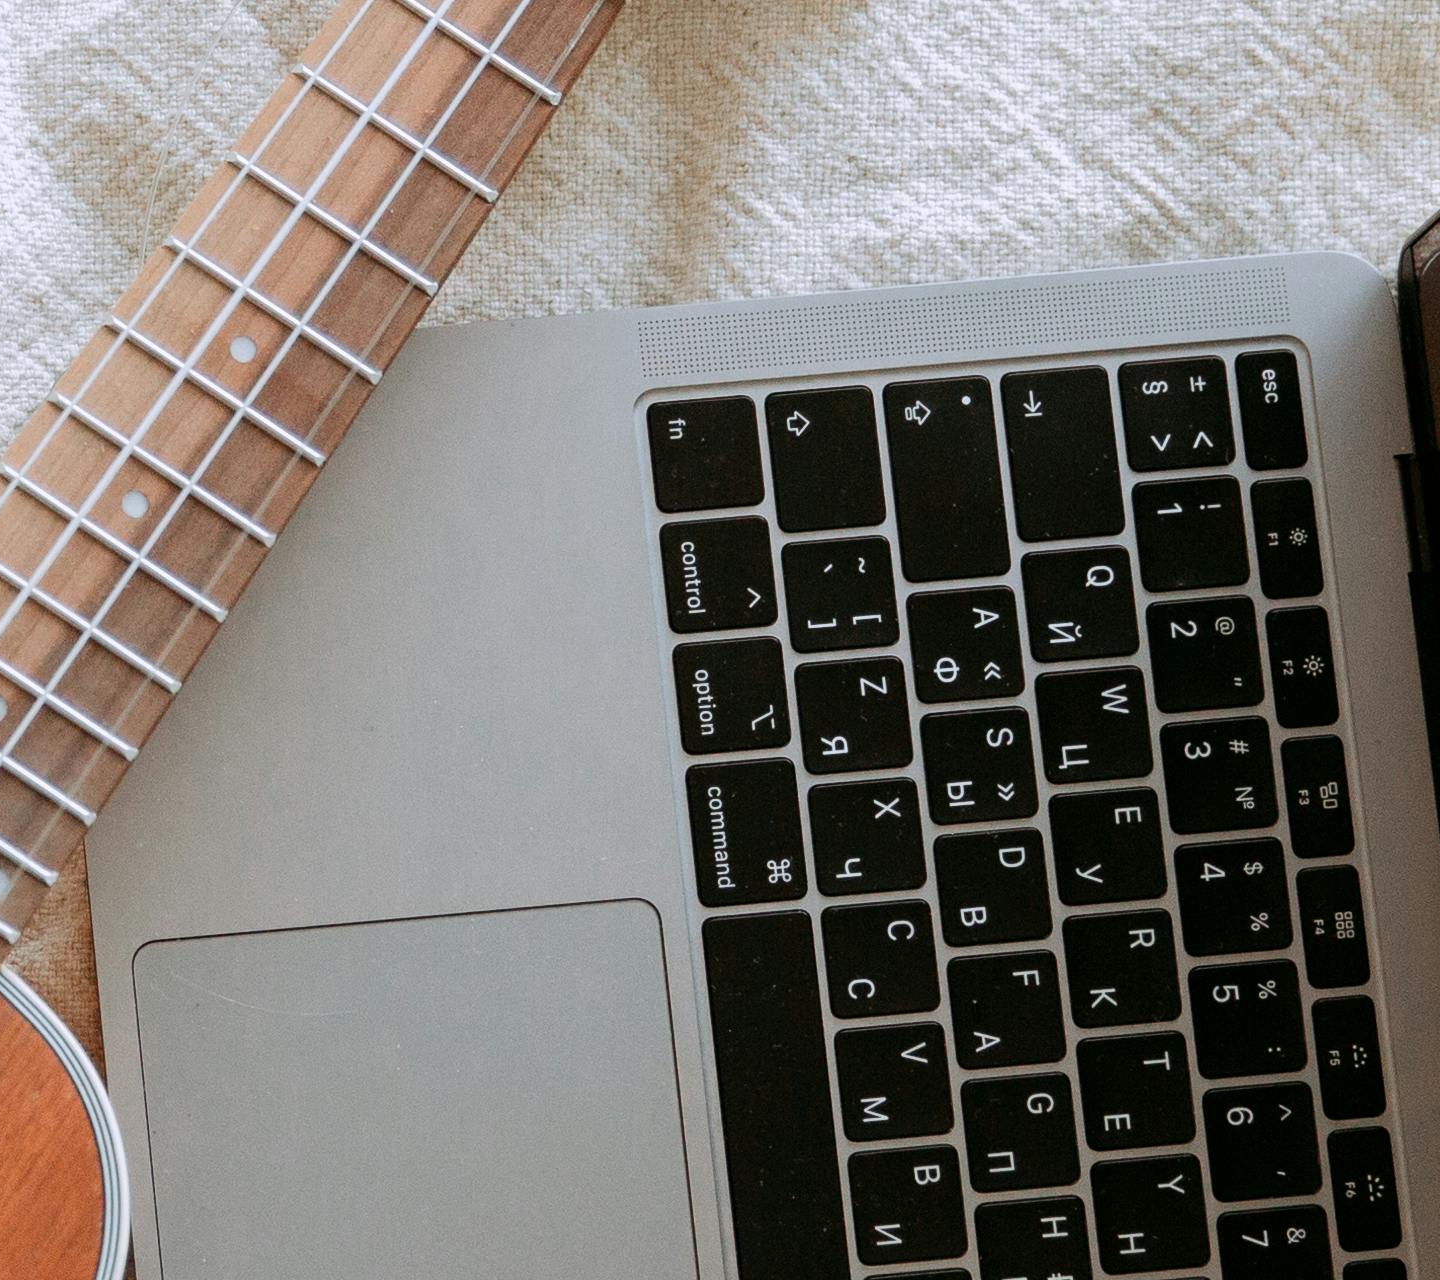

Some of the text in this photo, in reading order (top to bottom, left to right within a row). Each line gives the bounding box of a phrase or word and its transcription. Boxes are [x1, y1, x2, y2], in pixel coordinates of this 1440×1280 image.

[1261, 368, 1279, 404] esc
[667, 417, 687, 440] fn
[1156, 502, 1183, 515] 1
[1267, 532, 1279, 546] F1
[680, 541, 707, 615] control
[1085, 565, 1115, 588] Q
[971, 607, 1000, 629] A
[1047, 621, 1083, 644] Й
[1170, 620, 1198, 639] 2
[933, 656, 961, 684] Ф
[1282, 659, 1294, 676] F2
[859, 675, 888, 697] Z
[691, 669, 717, 736] option
[1100, 683, 1130, 714] W
[820, 735, 849, 756] Я
[985, 727, 1014, 748] S
[1058, 743, 1090, 770] Ц
[1184, 741, 1212, 760] 3
[946, 780, 976, 807] Ы
[1298, 789, 1310, 806] F3
[873, 797, 902, 820] X
[1114, 806, 1142, 825] E
[707, 786, 737, 889] command
[835, 857, 863, 879] Ч
[998, 846, 1026, 868] D
[1199, 862, 1226, 882] 4
[886, 919, 915, 942] C
[1313, 919, 1325, 935] F4
[1128, 928, 1156, 949] R
[1012, 969, 1041, 986] F
[1212, 984, 1240, 1003] 5
[900, 1041, 929, 1064] V
[1143, 1050, 1171, 1071] T
[1329, 1050, 1341, 1066] F5
[1026, 1092, 1055, 1115] G
[1226, 1106, 1254, 1126] 6
[987, 1151, 1016, 1173] П
[913, 1164, 941, 1186] B
[1157, 1174, 1185, 1194] Y
[1345, 1181, 1357, 1198] F6
[874, 1223, 903, 1246] И
[1040, 1216, 1069, 1239] H
[1241, 1229, 1269, 1247] 7
